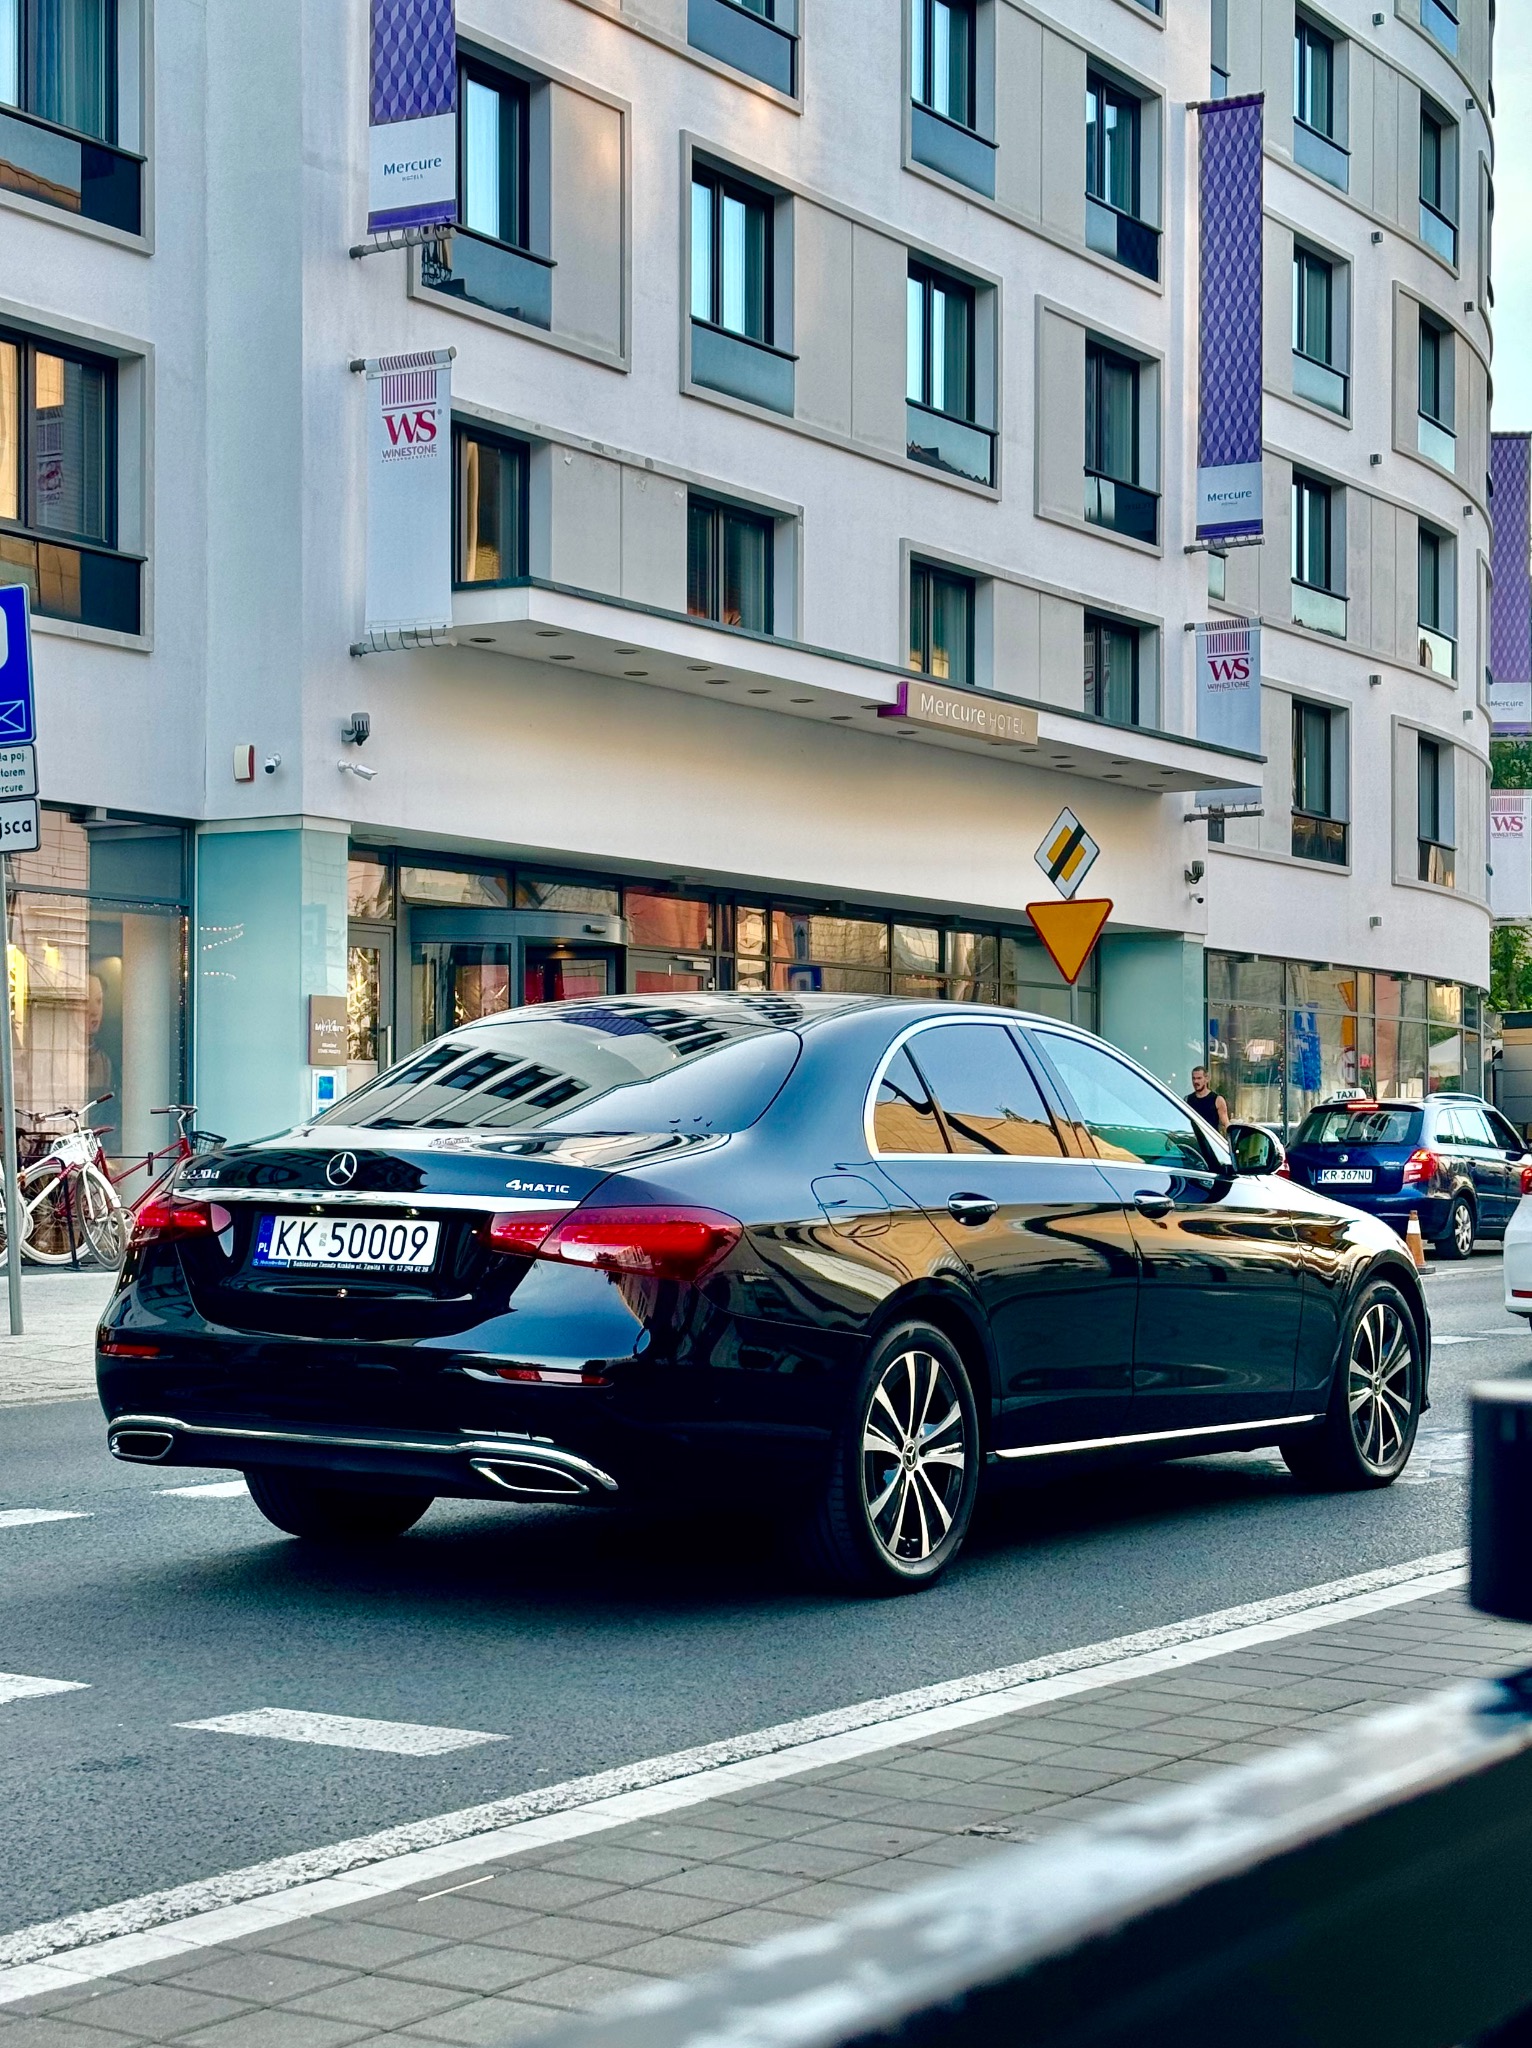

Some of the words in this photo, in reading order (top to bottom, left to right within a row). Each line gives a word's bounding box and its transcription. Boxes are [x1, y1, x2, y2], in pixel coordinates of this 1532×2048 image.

[383, 157, 442, 176] Mercure
[381, 409, 437, 446] WS
[381, 444, 437, 459] WINESTONE
[1207, 490, 1252, 502] Mercure
[1207, 657, 1250, 682] WS
[921, 692, 986, 726] Mercure
[989, 712, 1026, 735] HOTEL
[1491, 816, 1524, 832] WS
[1336, 1090, 1357, 1099] TAXI
[1323, 1170, 1338, 1181] KR
[1340, 1170, 1371, 1181] 367NU
[505, 1179, 570, 1194] 4MATIC
[257, 1242, 269, 1253] PL
[275, 1220, 319, 1257] KK
[327, 1222, 429, 1262] 50009
